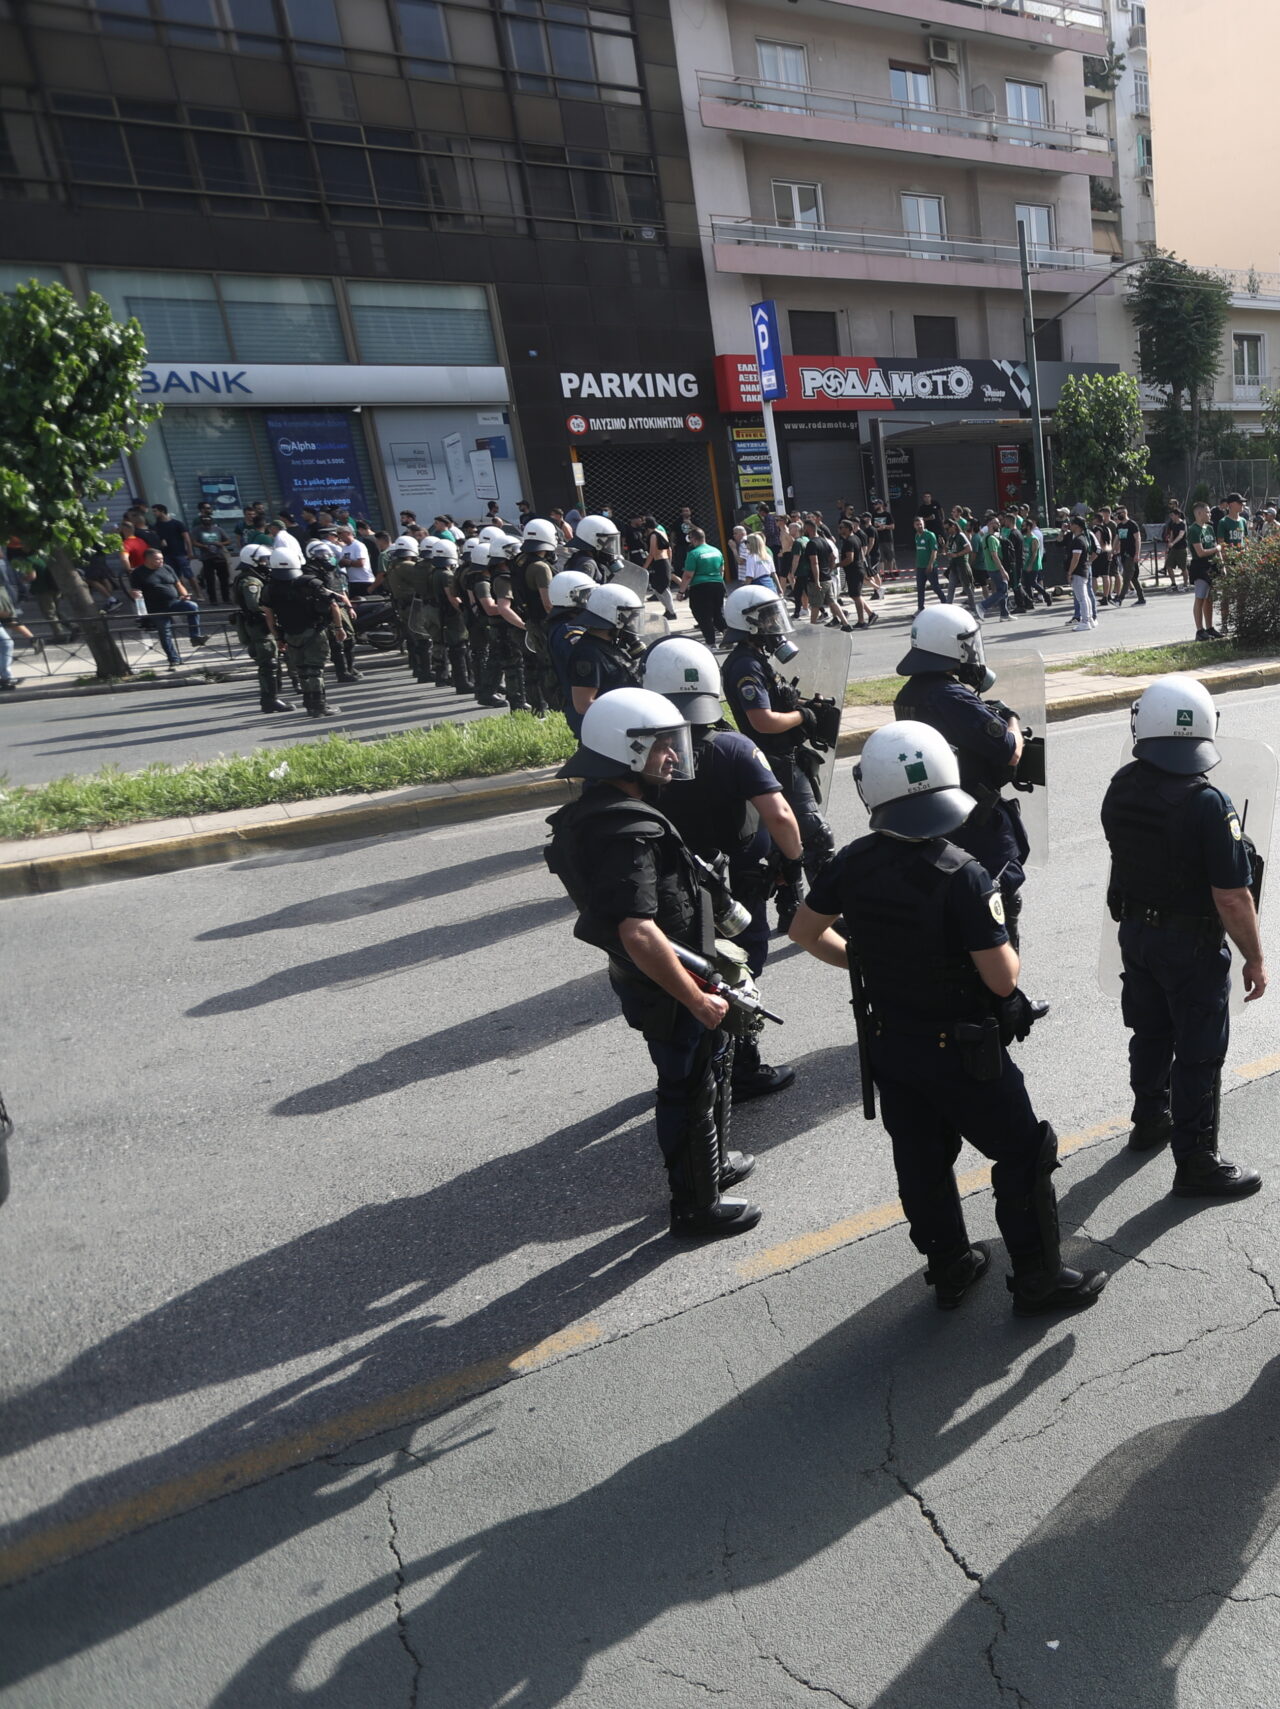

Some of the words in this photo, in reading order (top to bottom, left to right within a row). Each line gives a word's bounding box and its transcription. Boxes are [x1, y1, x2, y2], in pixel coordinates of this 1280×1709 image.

[141, 370, 254, 394] BANK
[560, 372, 699, 398] PARKING
[588, 417, 627, 431] ΠΛΥΣΙΜΟ
[628, 416, 685, 430] ΑΥΤΟΚΙΝΗΤΩΝ
[784, 421, 858, 430] www.rodamoto.gr
